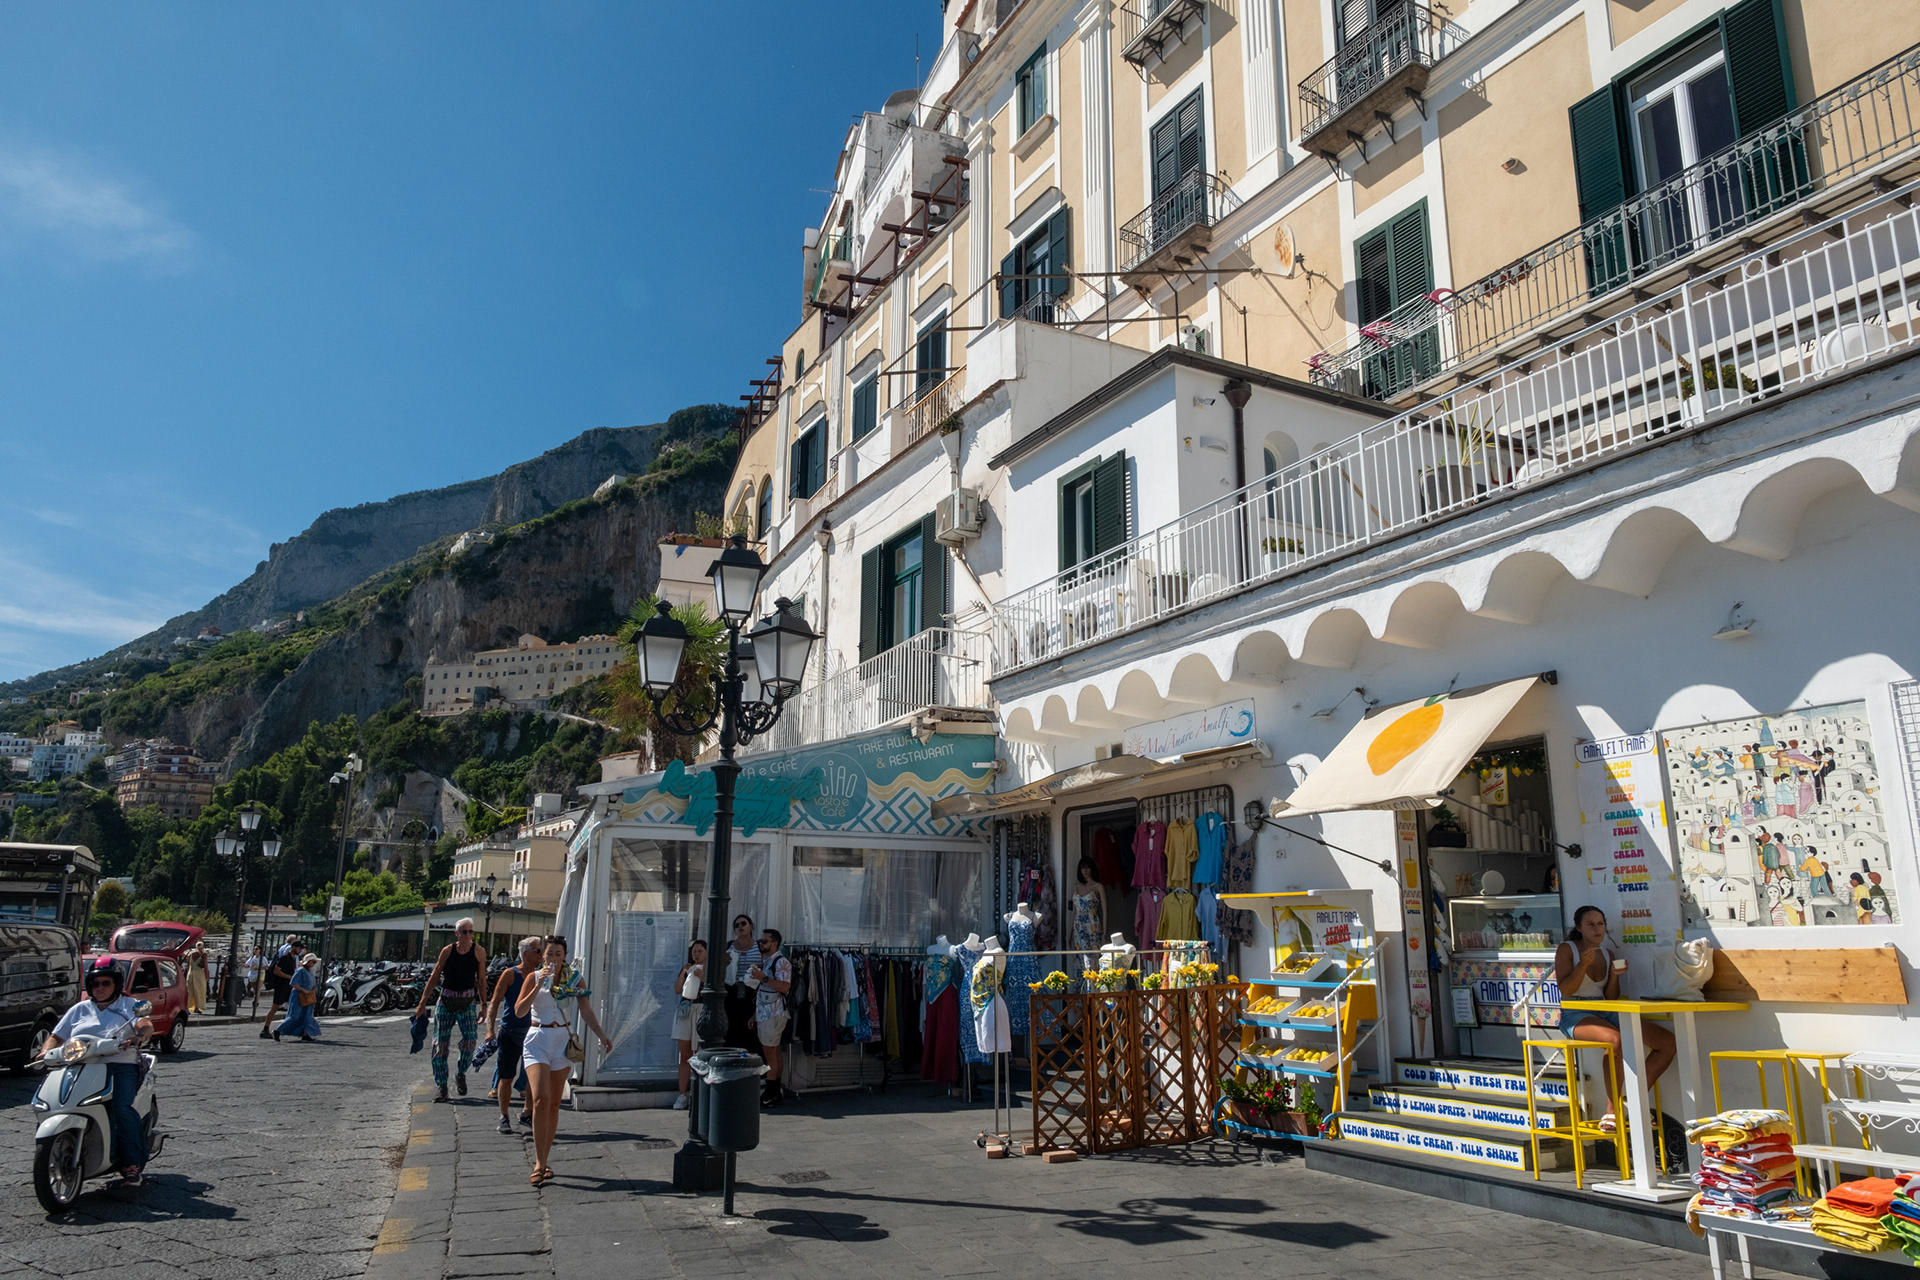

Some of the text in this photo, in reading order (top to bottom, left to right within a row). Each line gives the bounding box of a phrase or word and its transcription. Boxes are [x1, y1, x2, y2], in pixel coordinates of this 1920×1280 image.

[1194, 706, 1233, 748] Amalfi
[856, 741, 885, 755] TAKE
[1583, 740, 1617, 759] AMALFI
[876, 743, 955, 769] & RESTAURANT
[758, 766, 768, 776] e
[770, 757, 798, 775] CAFÈ
[1603, 760, 1632, 772] LEMON
[1606, 769, 1631, 780] JUICE
[1609, 793, 1634, 804] JUICE
[732, 799, 791, 834] ight
[1604, 808, 1643, 820] GRANITA
[1613, 826, 1638, 837] FRUIT
[1620, 841, 1635, 850] ICE
[1613, 849, 1645, 860] CREAM
[1614, 865, 1648, 875] APEROL
[1621, 873, 1652, 883] LEMON
[1316, 911, 1339, 923] AMALFI
[1621, 909, 1652, 918] SHAKE
[1326, 924, 1349, 936] LEMON
[1623, 925, 1654, 934] LEMON
[1325, 933, 1351, 946] SORBET
[1622, 934, 1656, 944] SORBET
[1480, 980, 1526, 1003] AMALFI
[1404, 1068, 1426, 1080] COLD
[1429, 1071, 1461, 1084] DRINK
[1469, 1075, 1502, 1089] FRESH
[1373, 1095, 1401, 1108] APEROL
[1403, 1099, 1408, 1109] &
[1410, 1100, 1436, 1113] LEMON
[1472, 1108, 1525, 1126] LIMONCELLO
[1343, 1123, 1519, 1163] LEMON SORBET ICE CREAM MILK SHAKE
